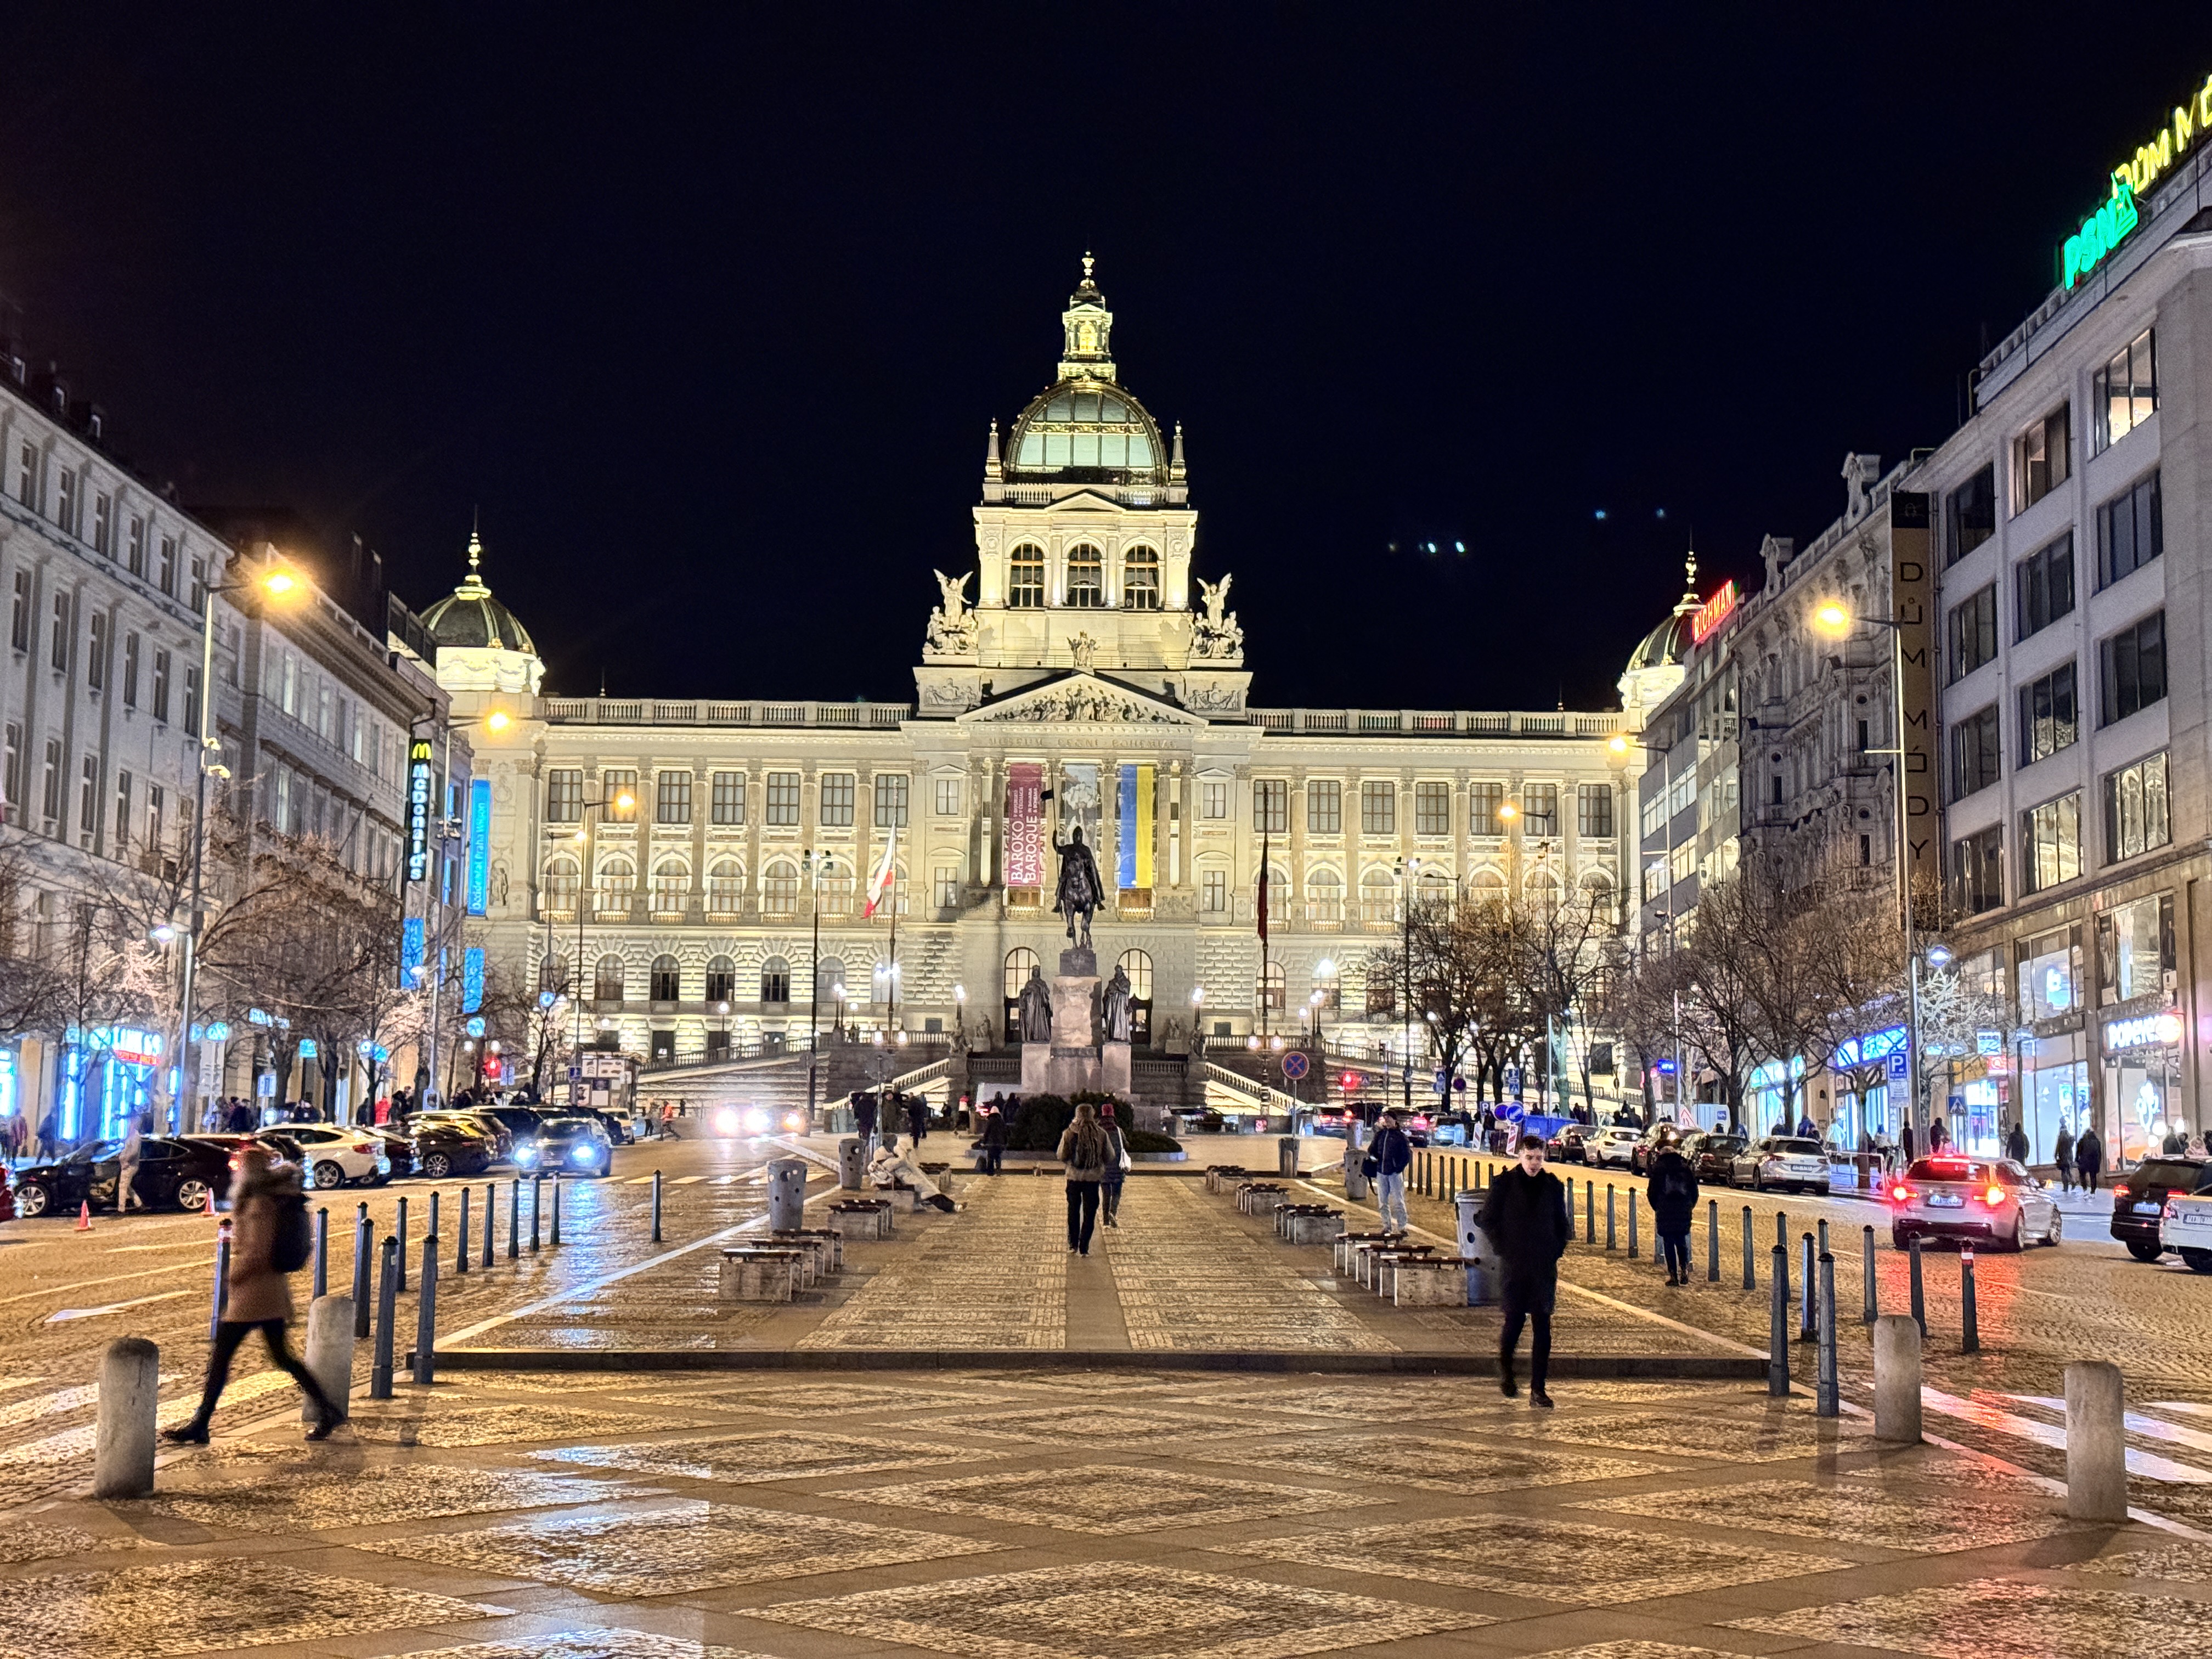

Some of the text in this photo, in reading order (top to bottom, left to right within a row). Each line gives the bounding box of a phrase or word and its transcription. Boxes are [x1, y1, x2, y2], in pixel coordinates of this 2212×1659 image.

[1691, 579, 1735, 641] RICHMAN
[1900, 562, 1929, 860] DŮM MÓDY
[1011, 821, 1024, 881] BAROKO
[1025, 815, 1039, 881] BAROQUE
[1892, 1056, 1904, 1072] P
